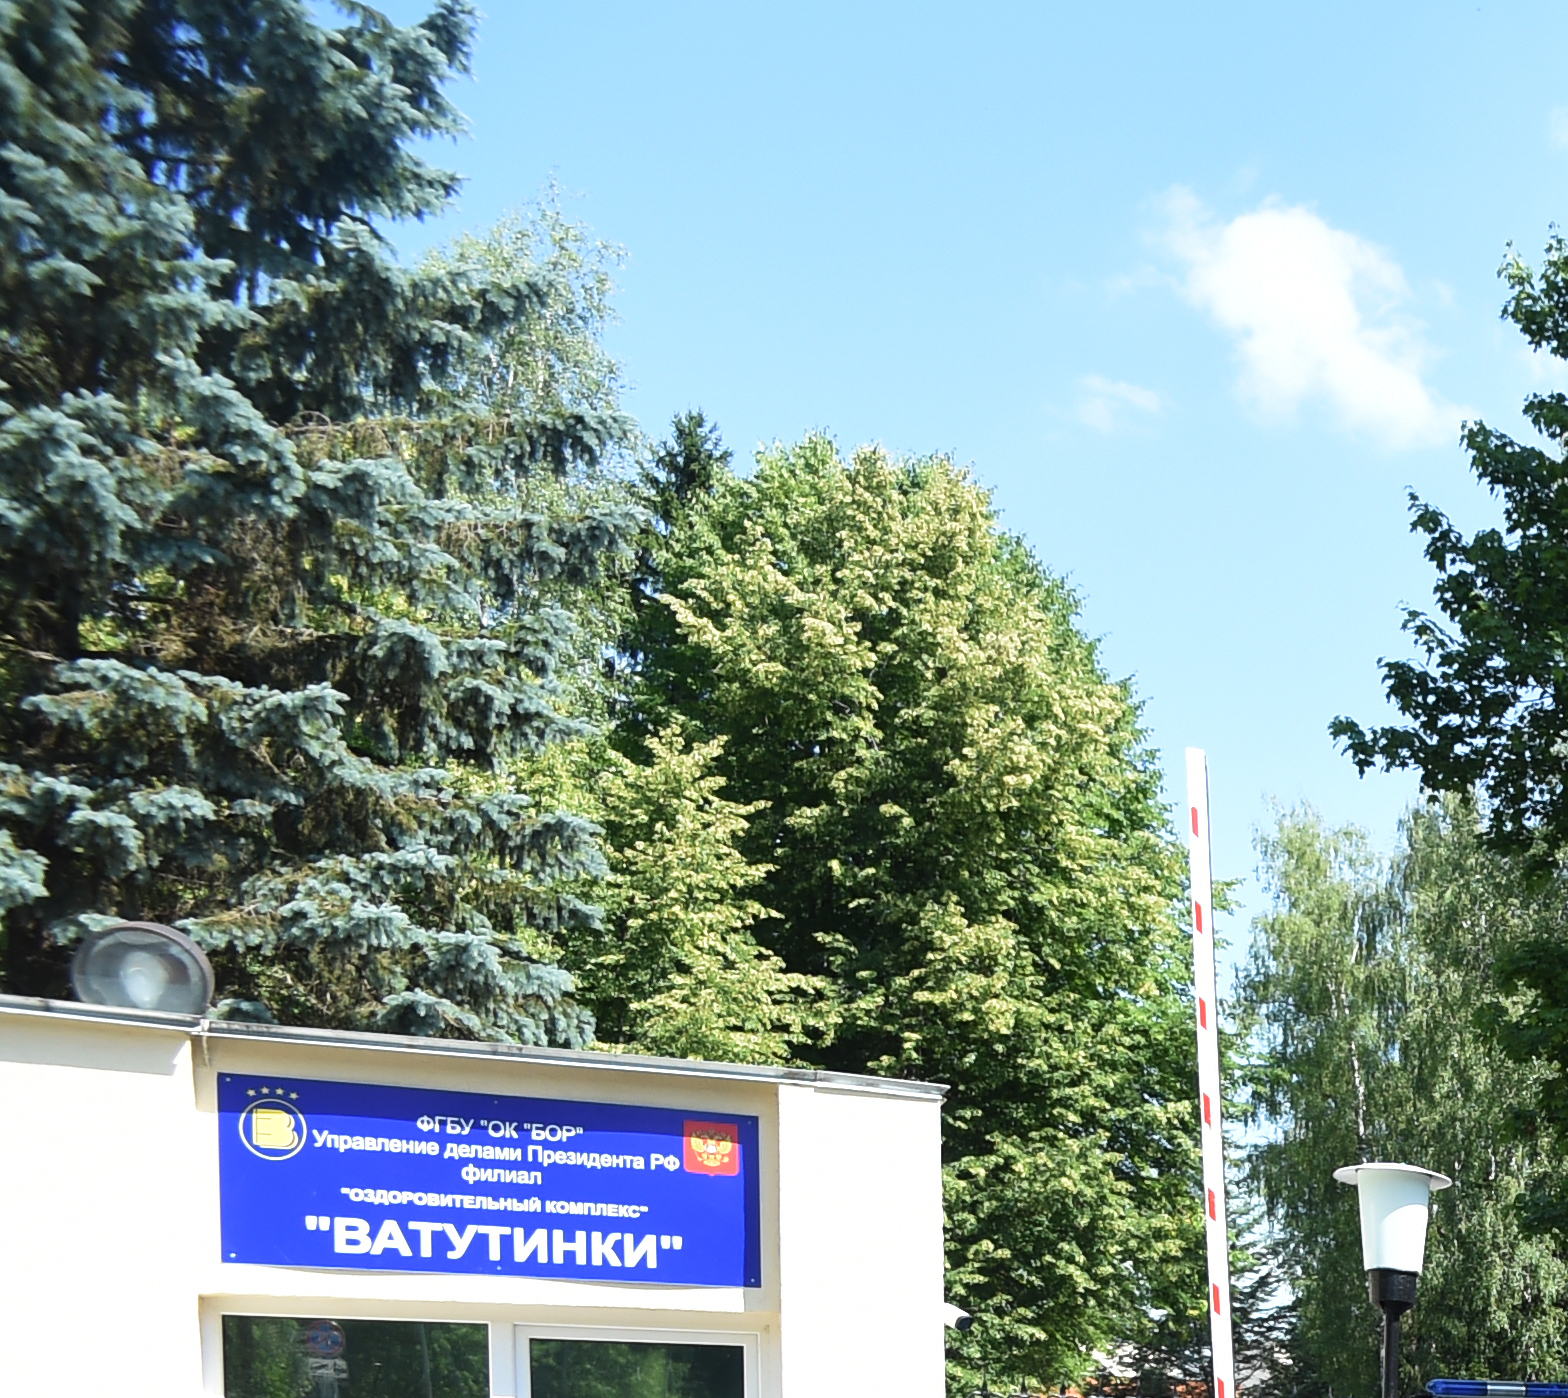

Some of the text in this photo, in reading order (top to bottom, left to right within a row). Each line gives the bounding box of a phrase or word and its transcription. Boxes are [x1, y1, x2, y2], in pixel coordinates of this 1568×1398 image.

[416, 1116, 583, 1142] ФГБУ "ОК "БОР"
[312, 1130, 680, 1171] Управление делами Президента РФ
[461, 1163, 542, 1186] филиал
[341, 1187, 648, 1218] "ОЗДОРОВИТЕЛЬНЫЙ КОМПЛЕКС"
[305, 1215, 683, 1269] "ВАТУТИНКИ"
